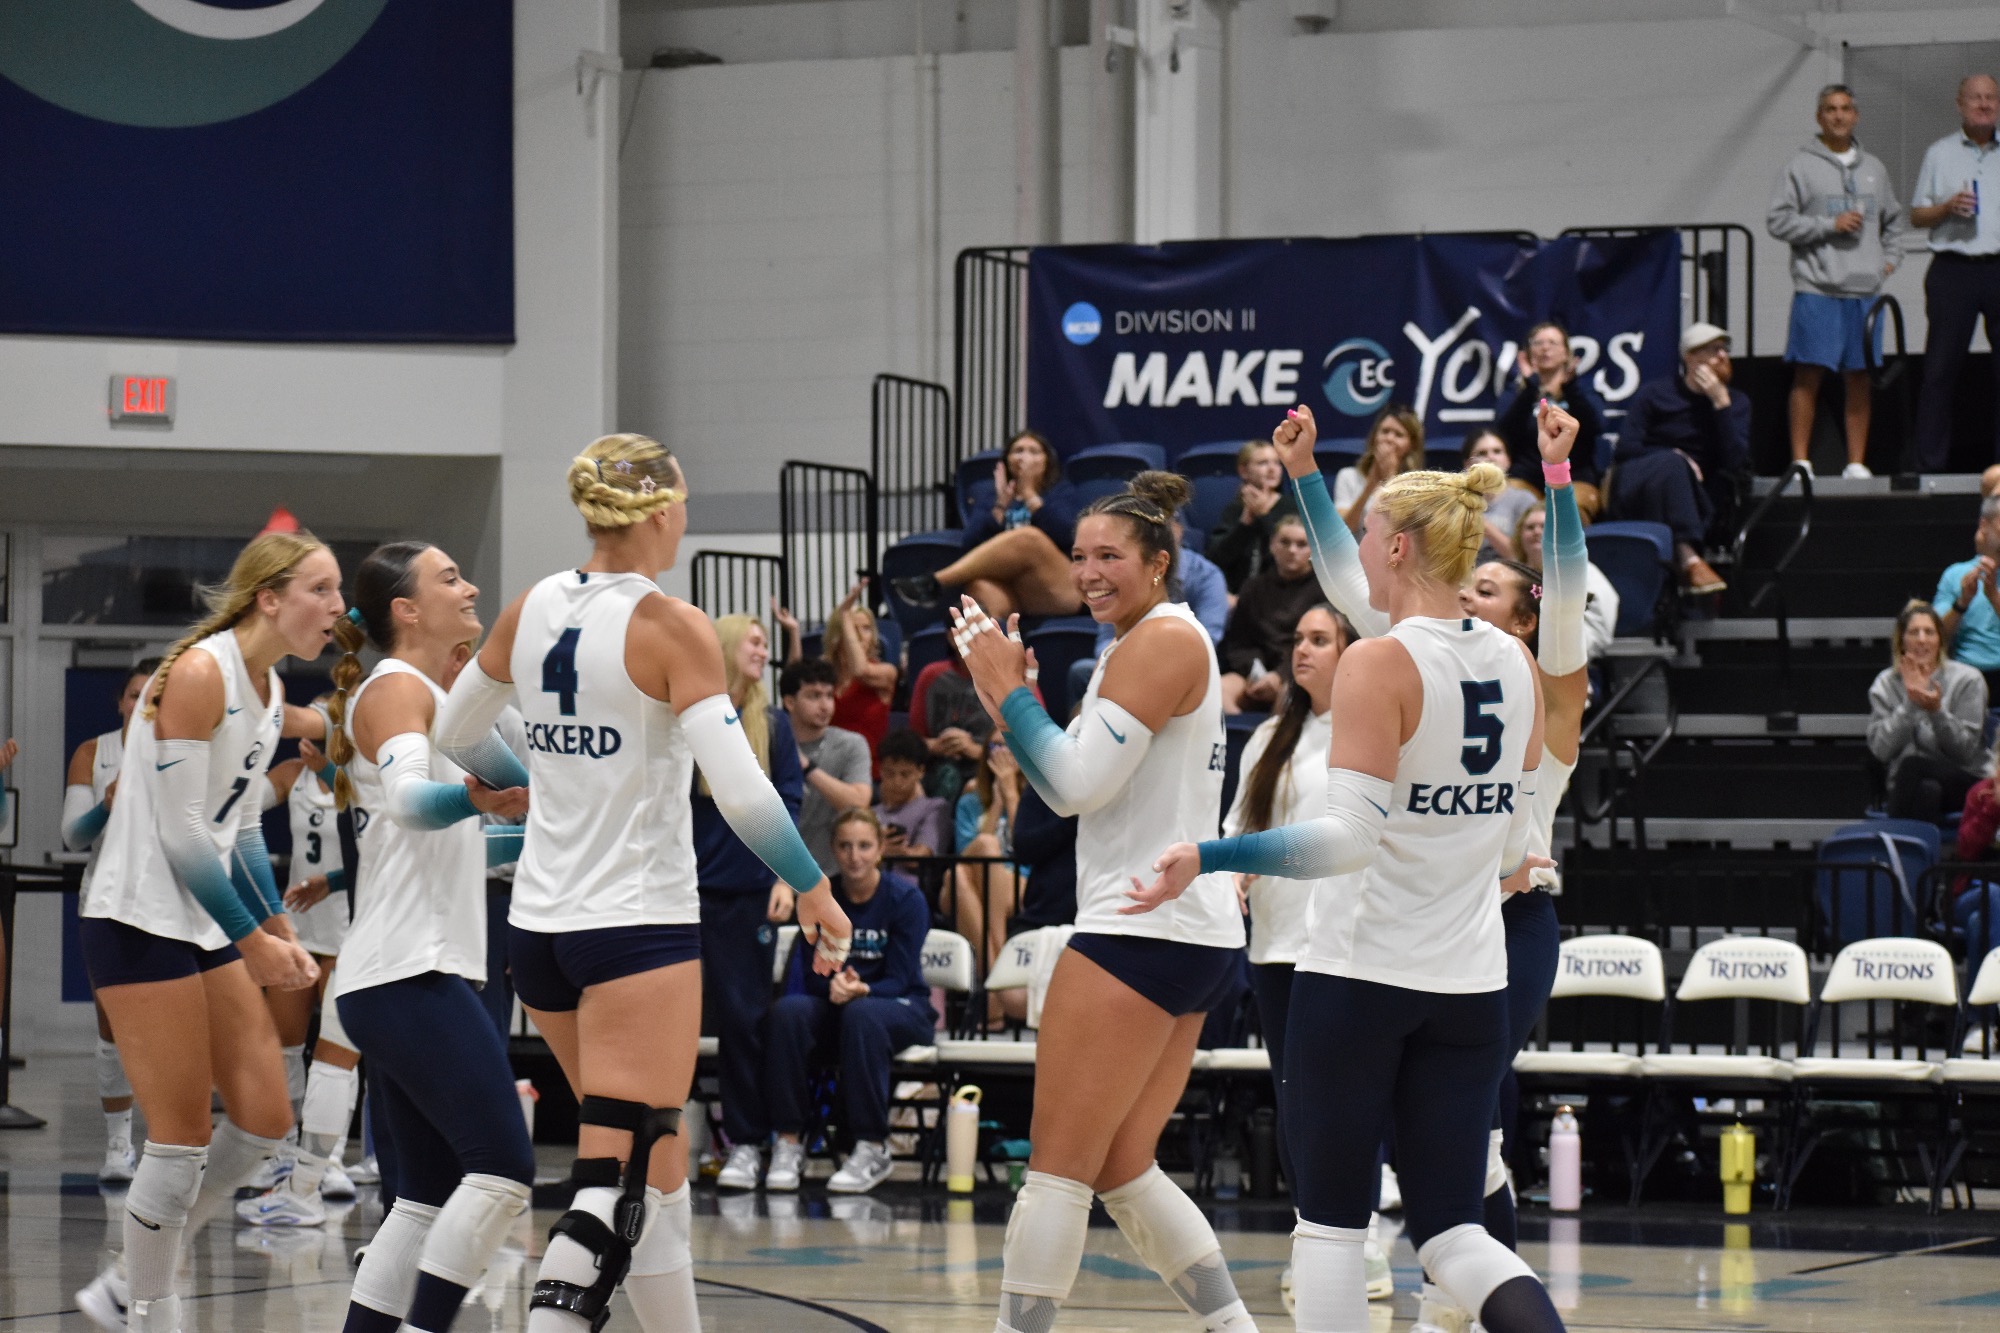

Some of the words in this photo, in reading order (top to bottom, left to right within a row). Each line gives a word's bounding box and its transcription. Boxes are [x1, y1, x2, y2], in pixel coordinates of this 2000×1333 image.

[1115, 308, 1233, 334] DIVISION
[1241, 308, 1256, 331] II
[124, 377, 168, 412] EXIT
[1103, 349, 1303, 408] MAKE
[1360, 359, 1397, 388] EC
[542, 627, 582, 716] 4
[1460, 679, 1505, 776] 5
[213, 776, 250, 823] 7
[1406, 781, 1516, 815] ECKER
[306, 831, 321, 864] 3
[1564, 954, 1642, 978] TRITONS
[1708, 958, 1787, 980] TRITONS
[1853, 957, 1934, 980] TRITONS
